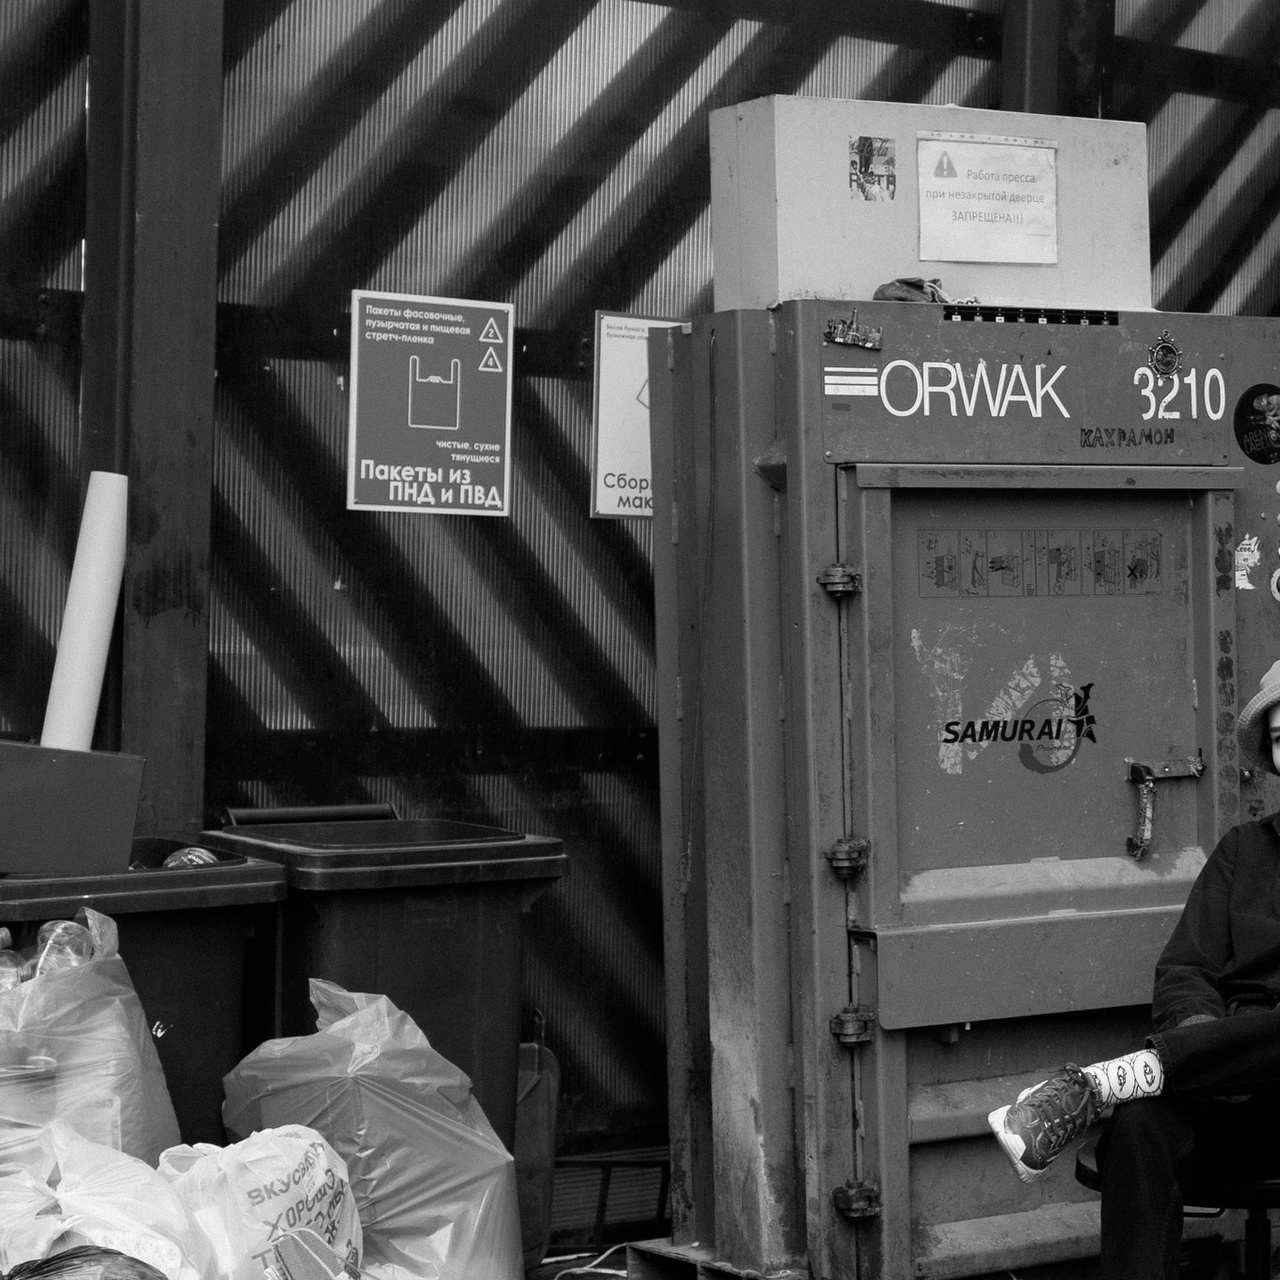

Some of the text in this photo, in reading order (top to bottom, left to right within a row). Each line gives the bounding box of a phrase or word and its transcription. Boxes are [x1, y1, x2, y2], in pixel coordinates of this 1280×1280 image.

[967, 169, 1036, 183] Работа пресса
[926, 190, 1045, 204] при незакрытой дверце
[951, 211, 1024, 224] ЗАПРЕЩЕНА!!!
[366, 305, 465, 323] Пакеты фасовочные,
[365, 319, 471, 335] пузырчатая и пищевая
[488, 328, 495, 338] 2
[365, 331, 435, 345] стретч-пленка
[487, 357, 494, 368] 4
[880, 359, 1071, 418] ORWAK
[1133, 366, 1226, 421] 3210
[435, 440, 500, 452] чистые, сухие
[450, 453, 500, 464] тянущиеся
[360, 459, 471, 484] Пакеты из
[603, 472, 649, 494] Сбор
[389, 481, 503, 509] ПНД и ПВД
[942, 718, 1064, 744] SAMURAI
